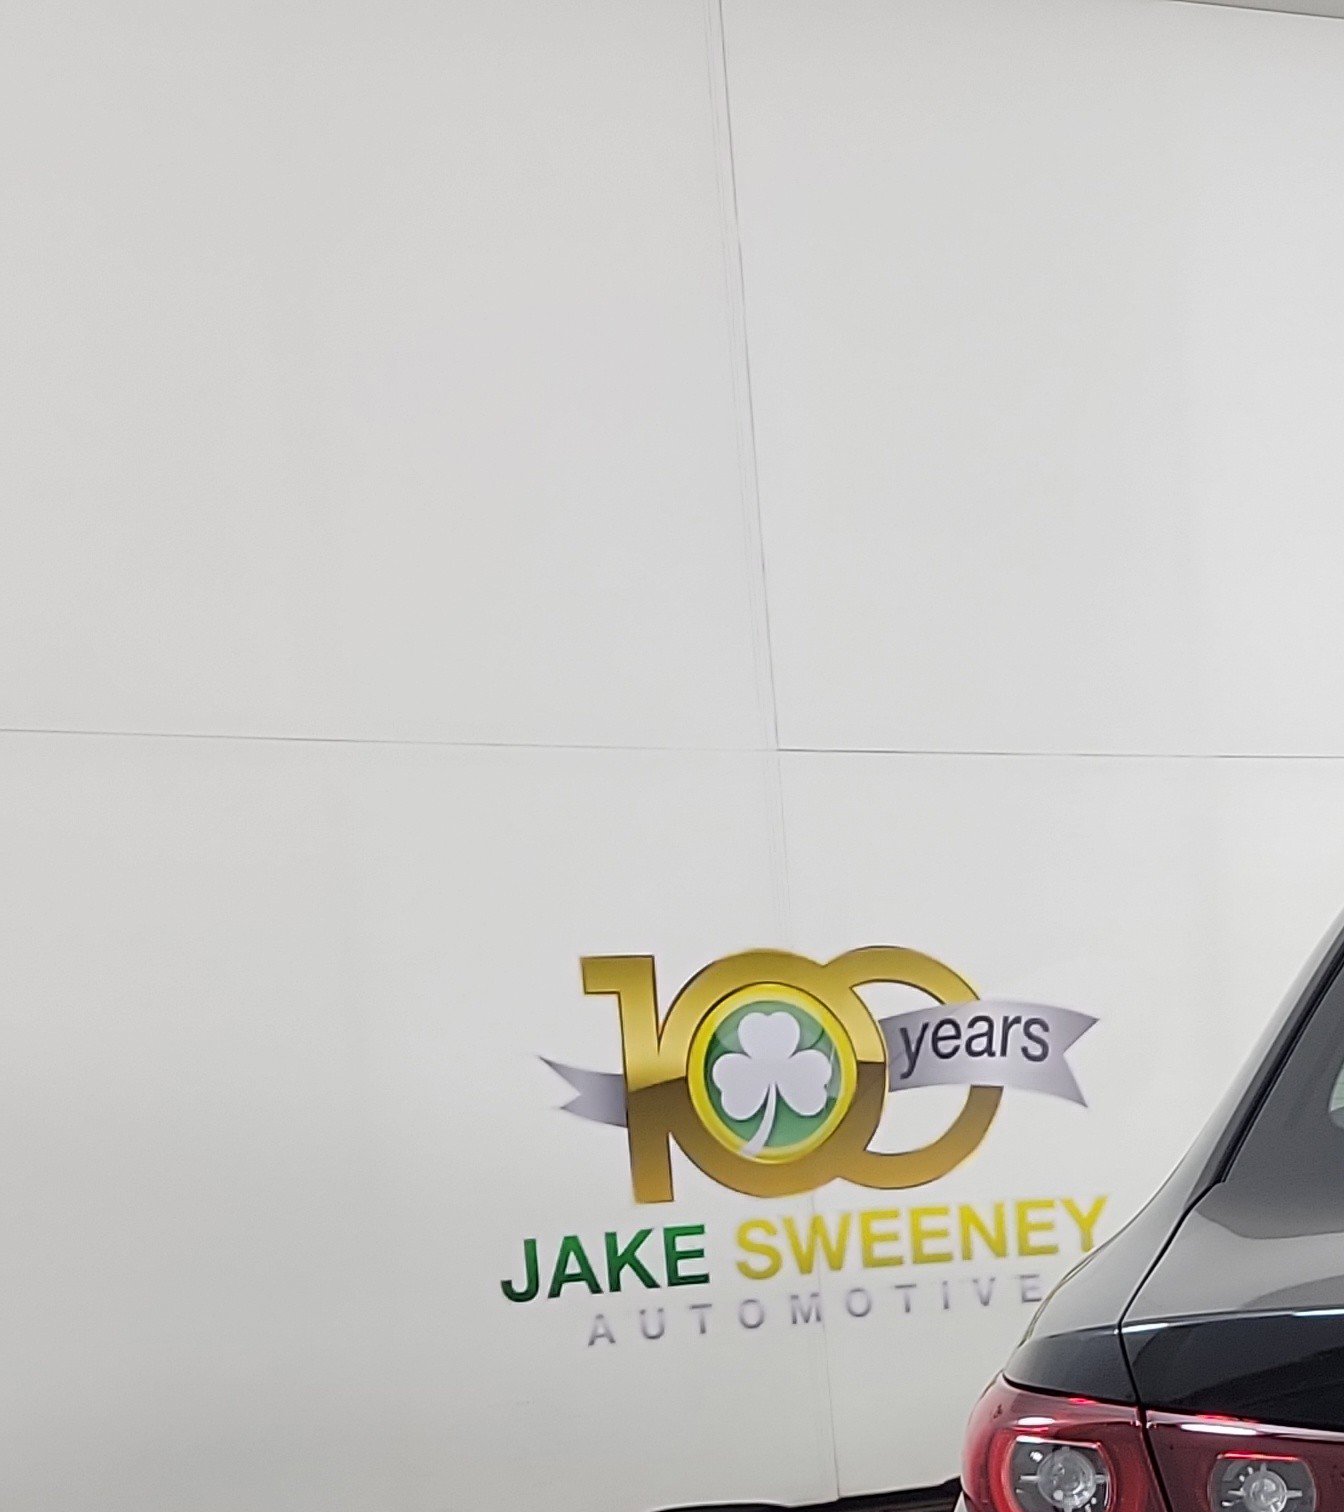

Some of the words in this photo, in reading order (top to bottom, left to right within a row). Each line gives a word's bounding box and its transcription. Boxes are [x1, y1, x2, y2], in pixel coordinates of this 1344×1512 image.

[900, 1014, 1052, 1080] years
[501, 1224, 710, 1302] JAKE
[734, 1197, 1108, 1280] SWEENEY
[587, 1275, 1045, 1347] AUTOMOTIVE
